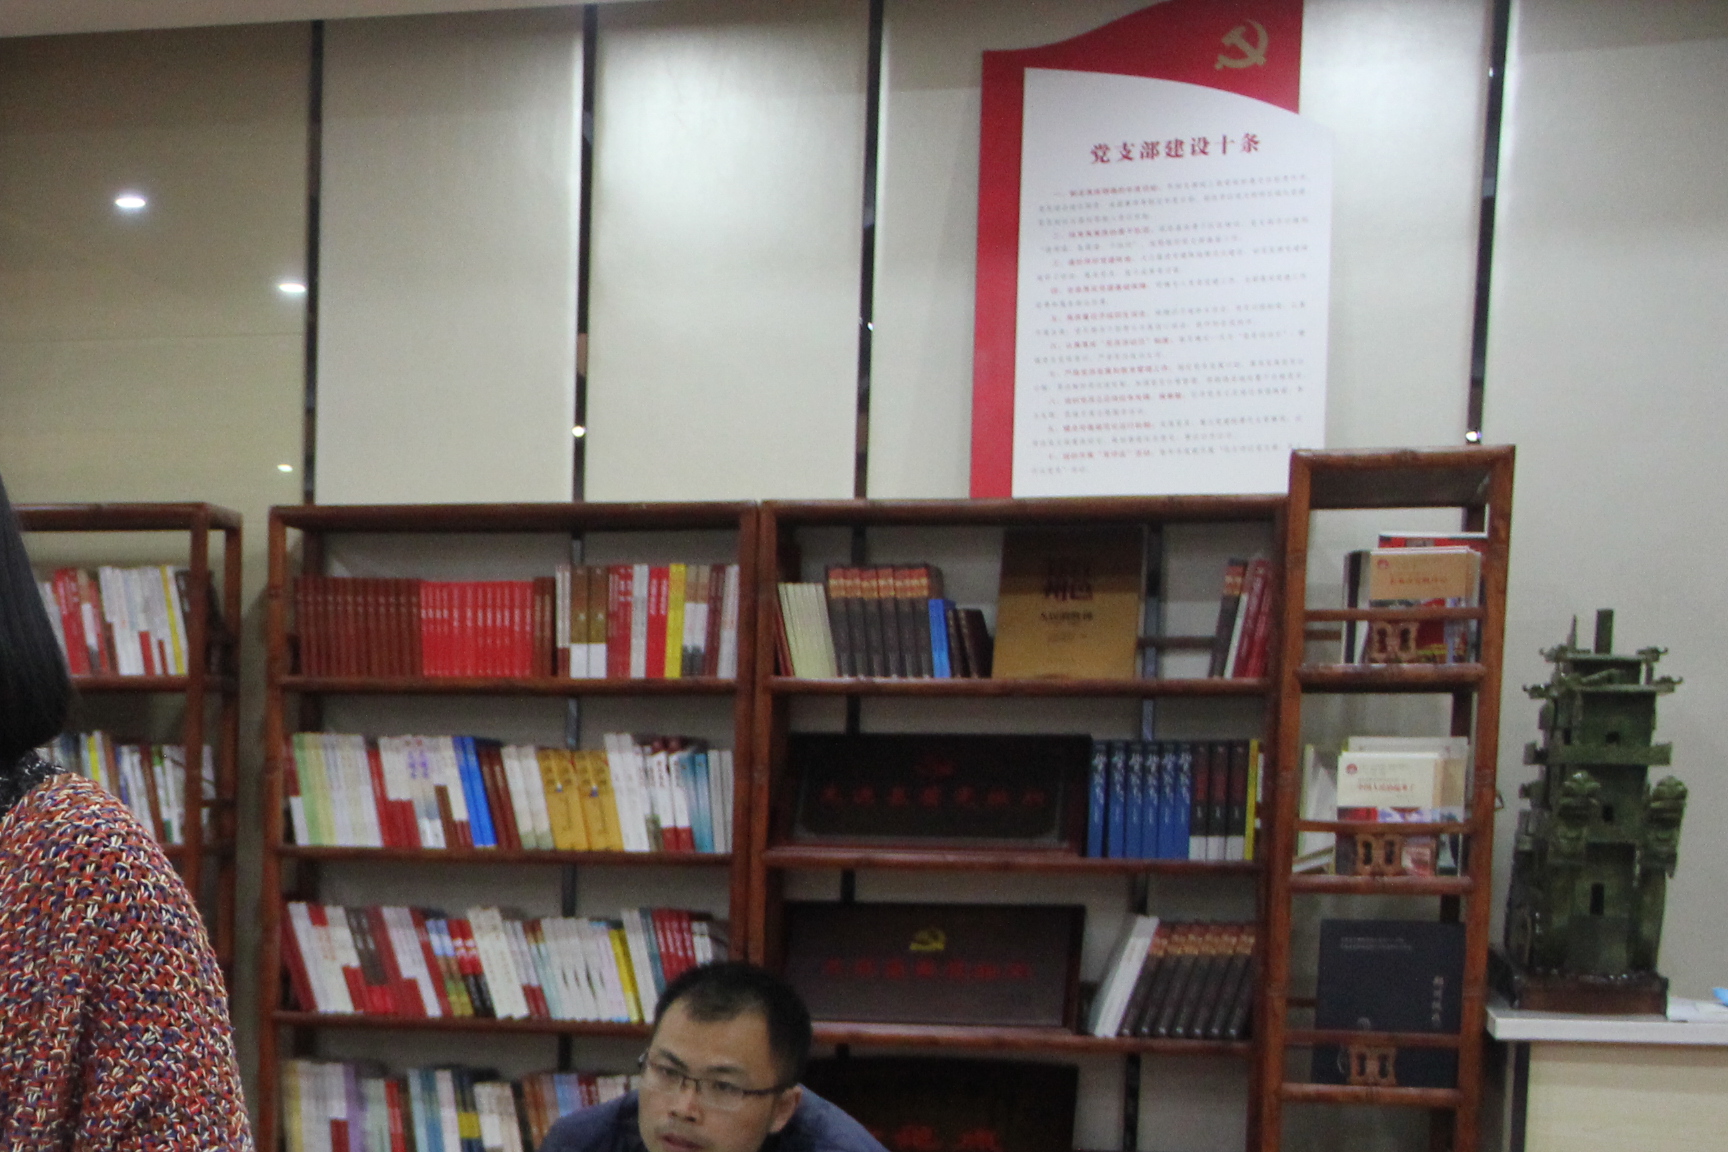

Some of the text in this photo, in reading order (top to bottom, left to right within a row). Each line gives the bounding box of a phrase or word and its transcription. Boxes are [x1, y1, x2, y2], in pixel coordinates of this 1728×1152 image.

[1090, 132, 1260, 164] 党支部建设十条
